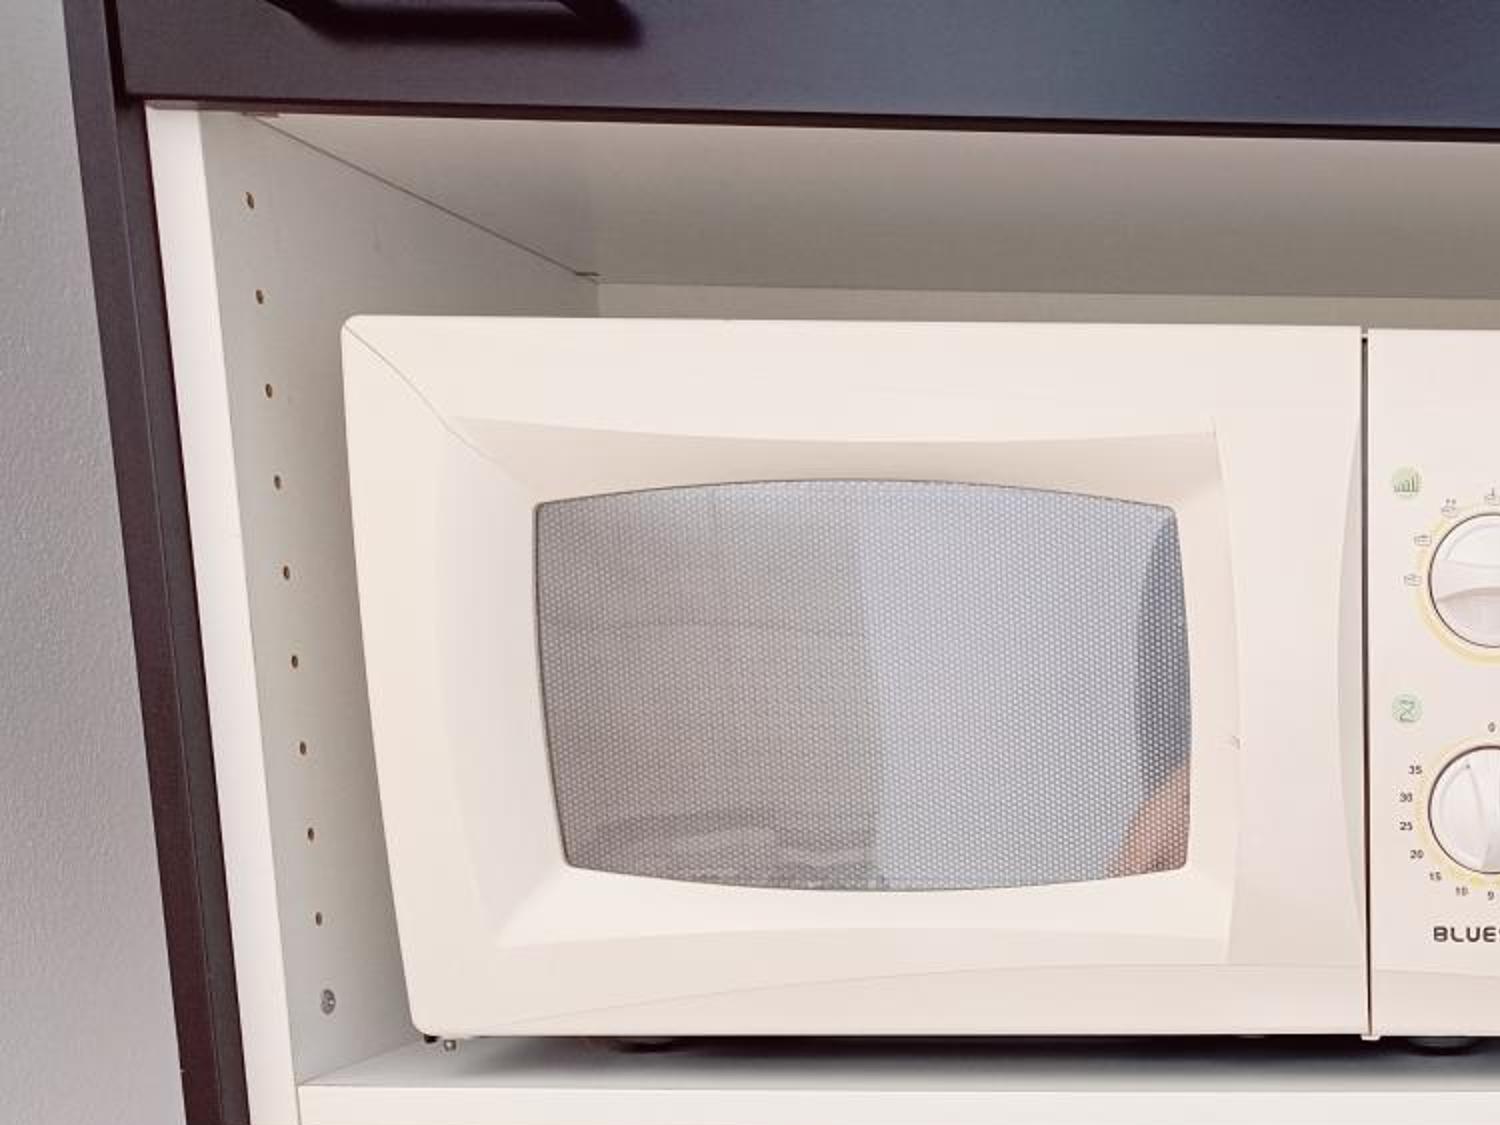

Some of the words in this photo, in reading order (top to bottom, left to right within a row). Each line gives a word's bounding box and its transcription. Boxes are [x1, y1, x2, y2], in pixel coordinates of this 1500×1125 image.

[1487, 721, 1496, 733] 0
[1409, 765, 1423, 775] 35
[1400, 792, 1413, 803] 30
[1399, 821, 1413, 831] 25
[1410, 849, 1423, 859] 20
[1429, 871, 1442, 881] 15
[1455, 886, 1468, 897] 10
[1487, 891, 1495, 901] 9
